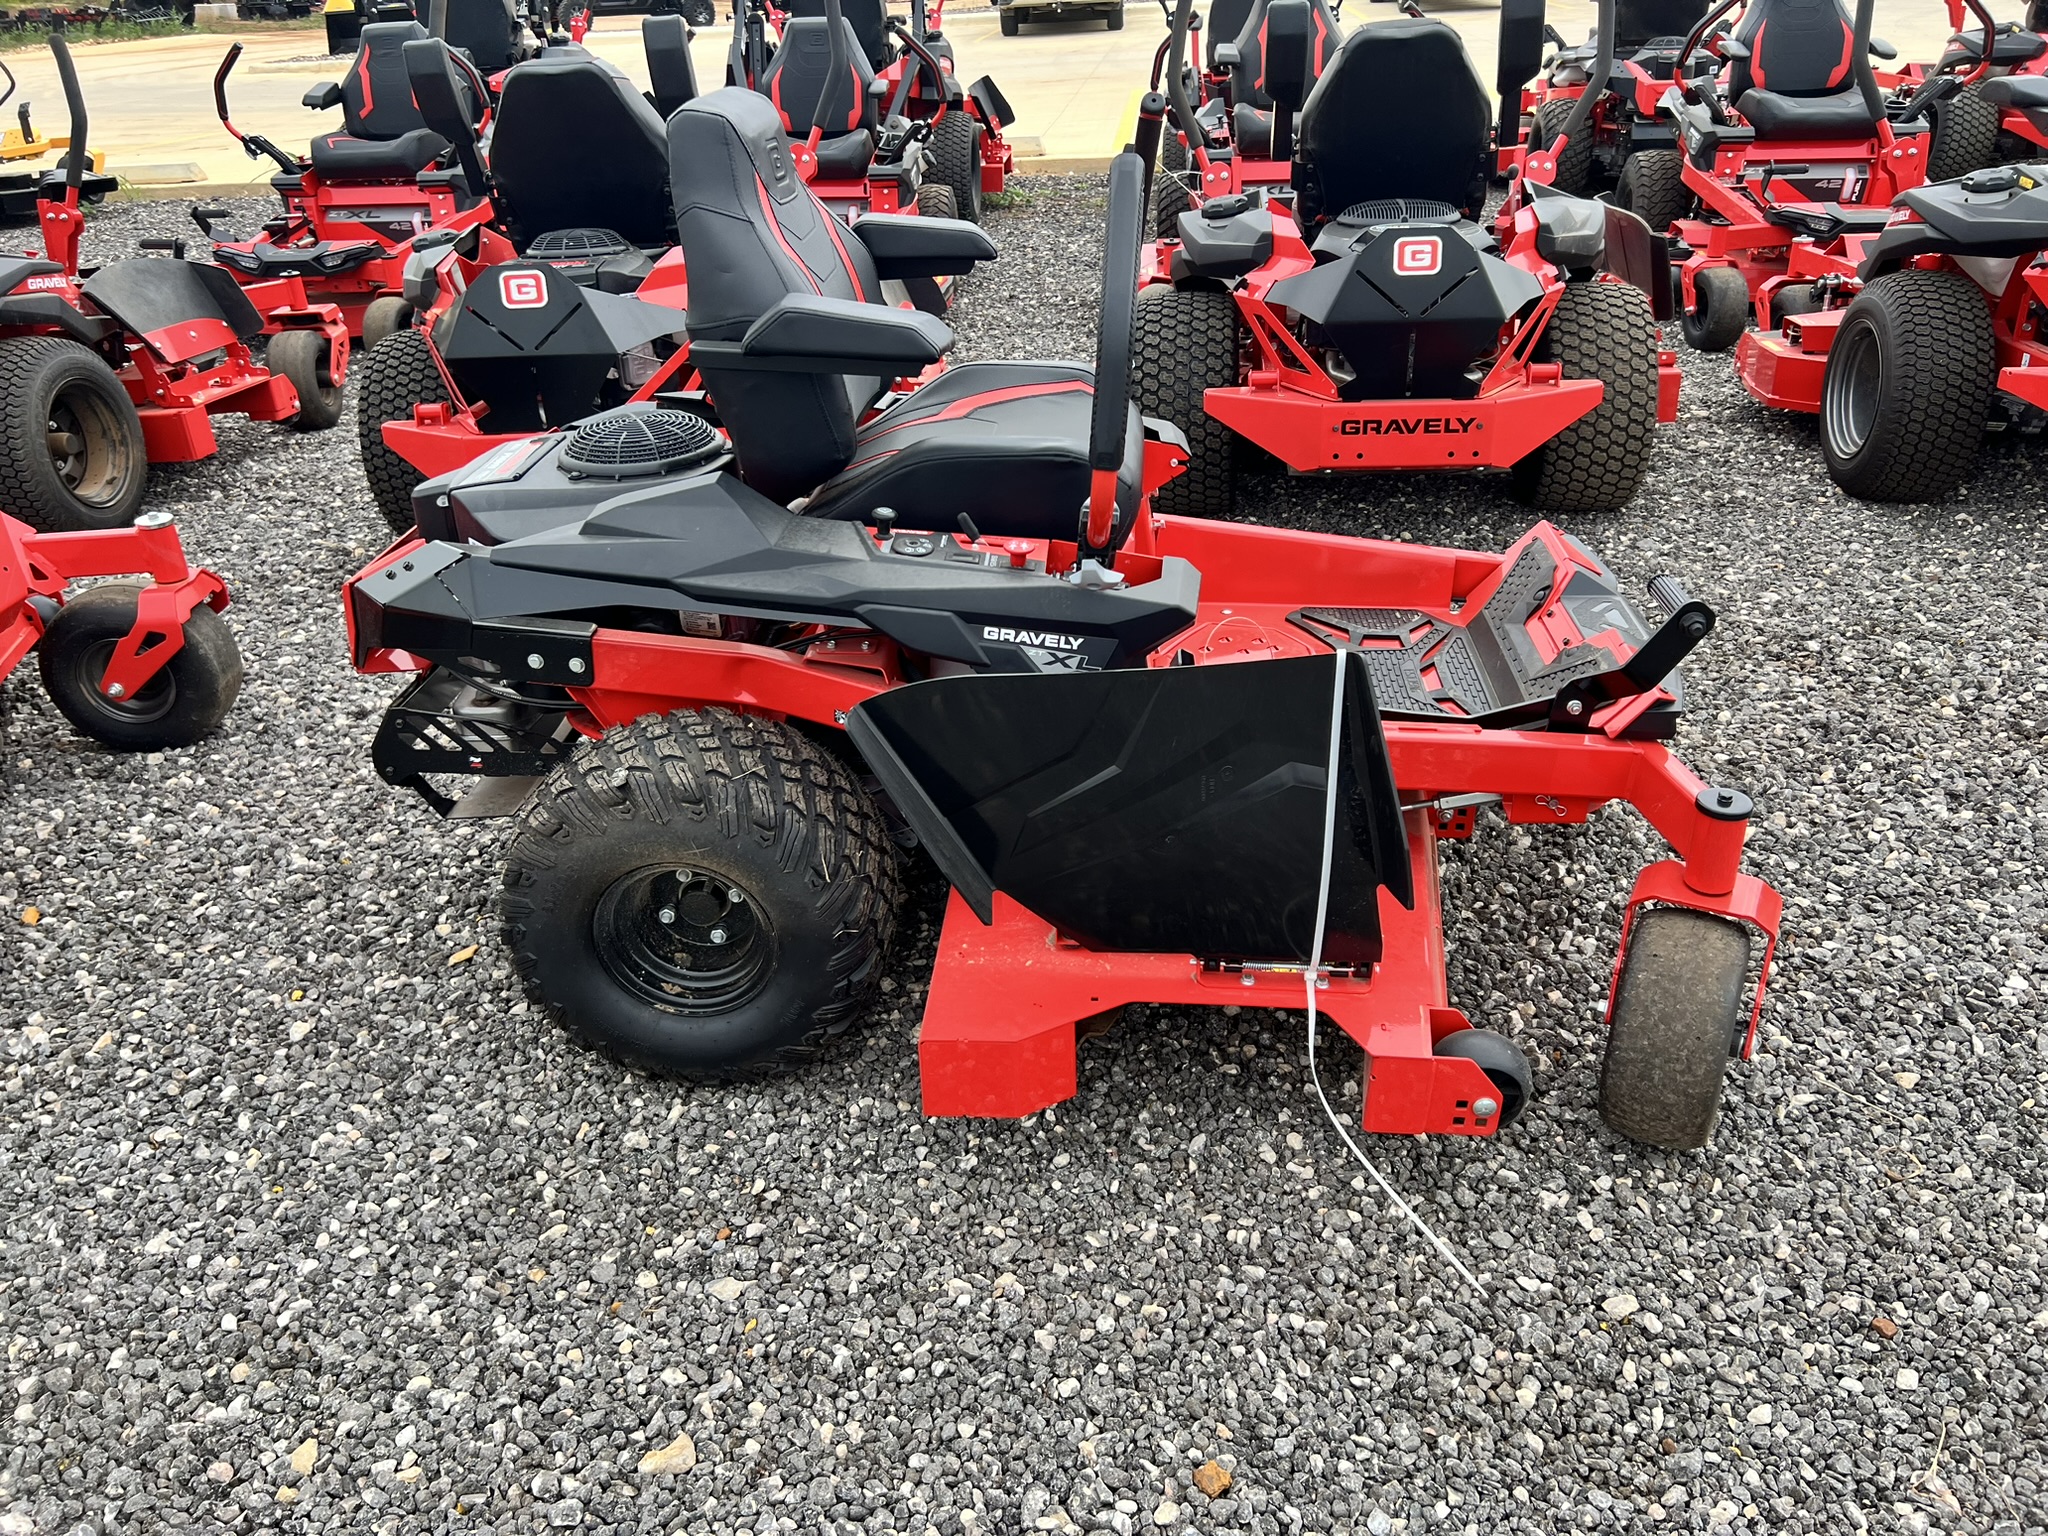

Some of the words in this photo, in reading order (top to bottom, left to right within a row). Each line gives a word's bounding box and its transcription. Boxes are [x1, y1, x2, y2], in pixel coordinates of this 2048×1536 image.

[1815, 179, 1841, 188] 42
[1851, 180, 1862, 201] FUEL
[389, 222, 412, 230] 42
[27, 277, 68, 290] GRAVELY
[1341, 417, 1477, 436] GRAVELY
[983, 626, 1084, 650] GRAVELY
